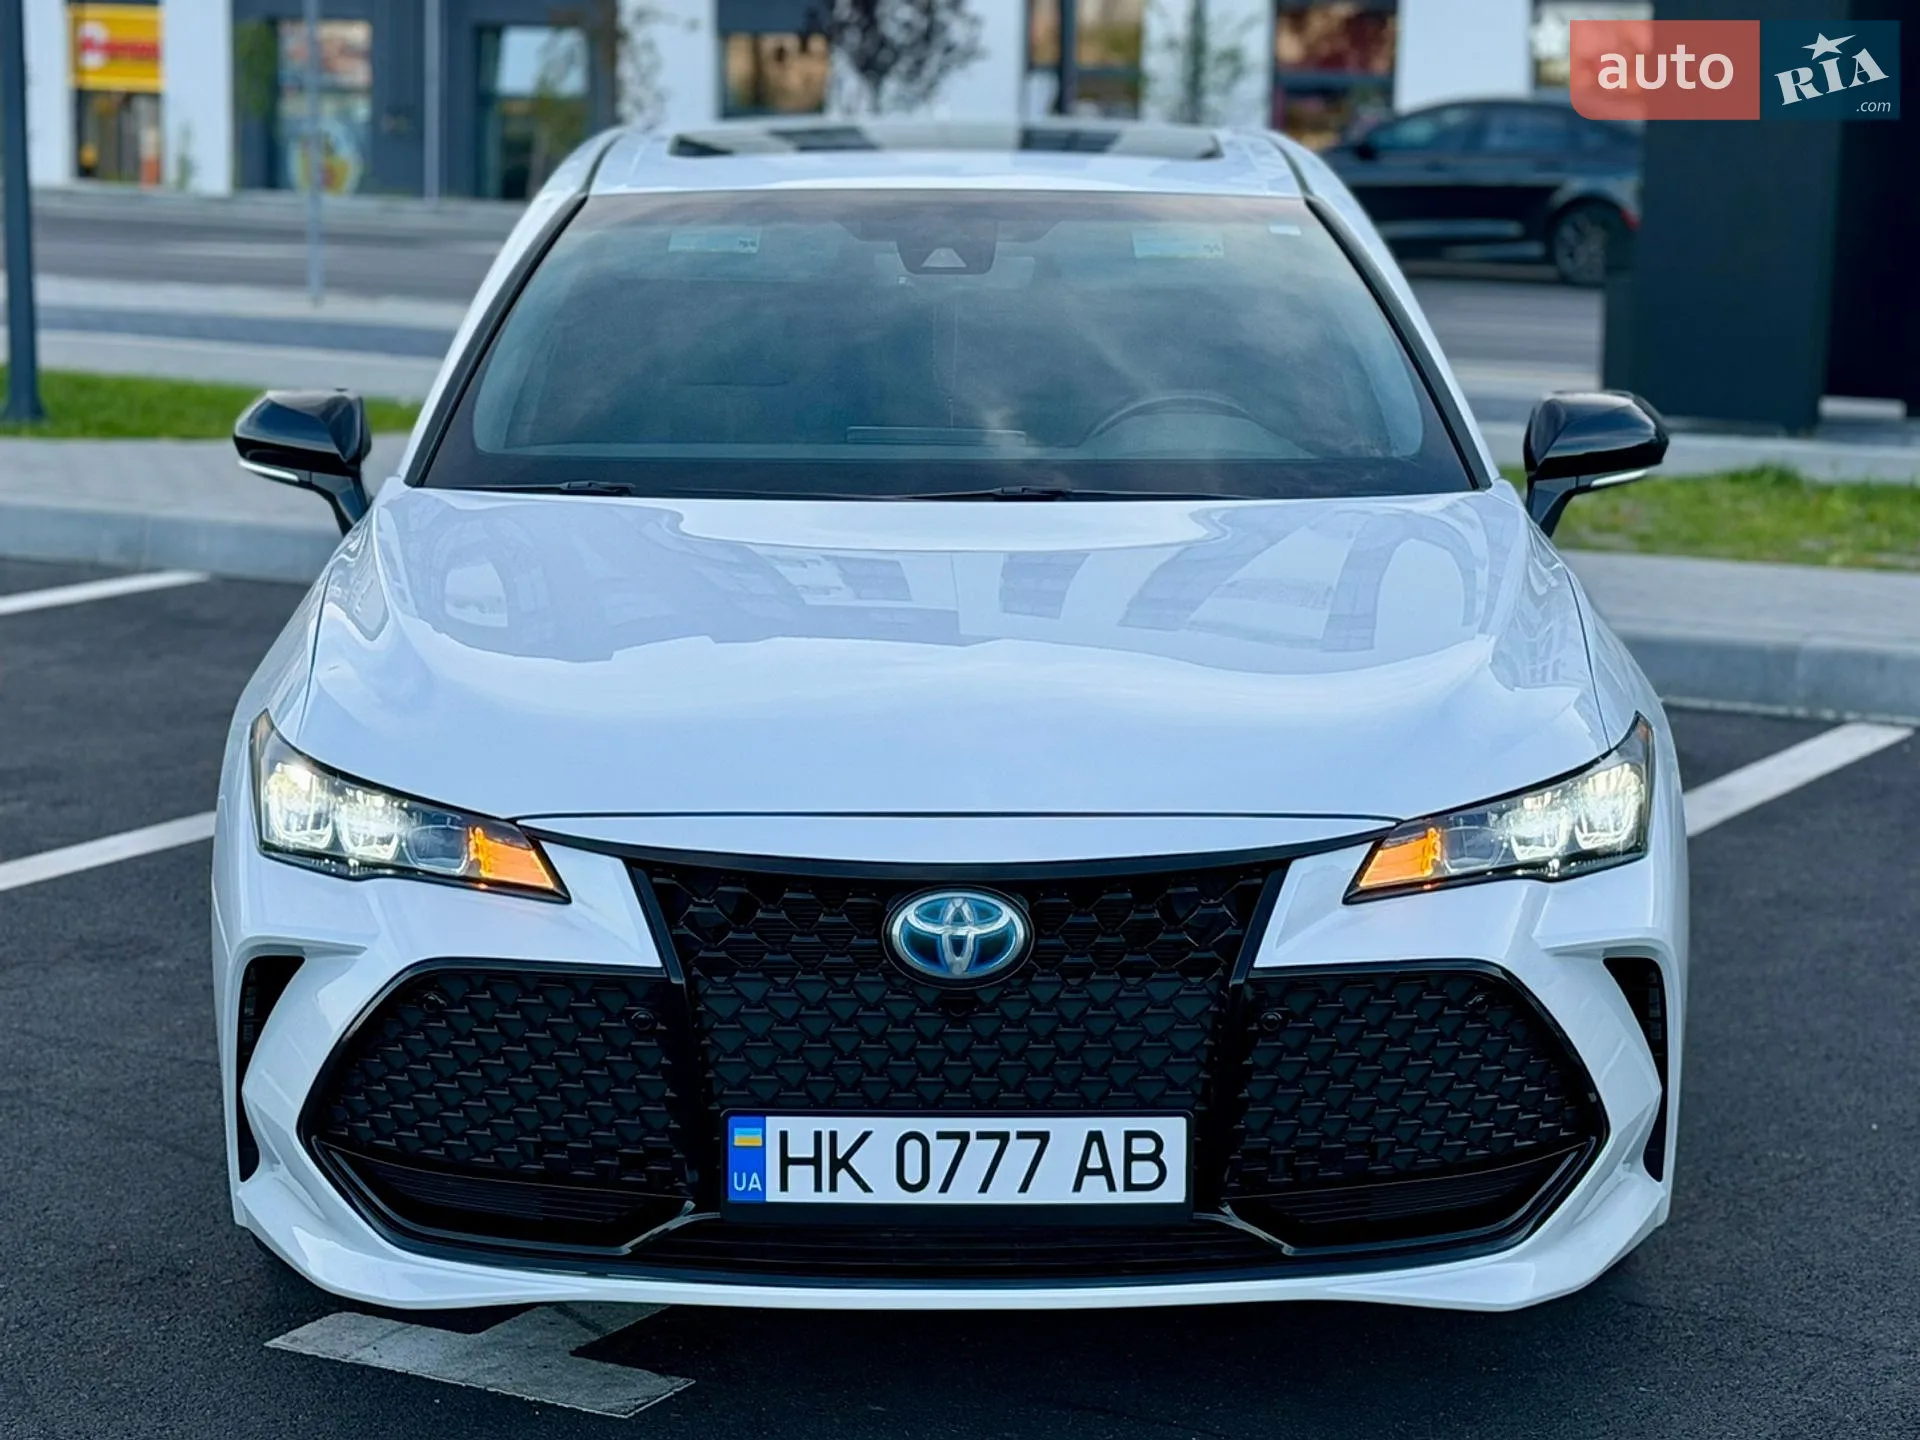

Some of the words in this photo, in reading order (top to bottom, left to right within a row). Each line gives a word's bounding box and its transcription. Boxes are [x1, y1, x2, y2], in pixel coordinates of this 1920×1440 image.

[733, 1172, 763, 1192] UA
[779, 1130, 874, 1193] HK
[895, 1130, 1051, 1194] 0777
[1071, 1130, 1168, 1193] AB
